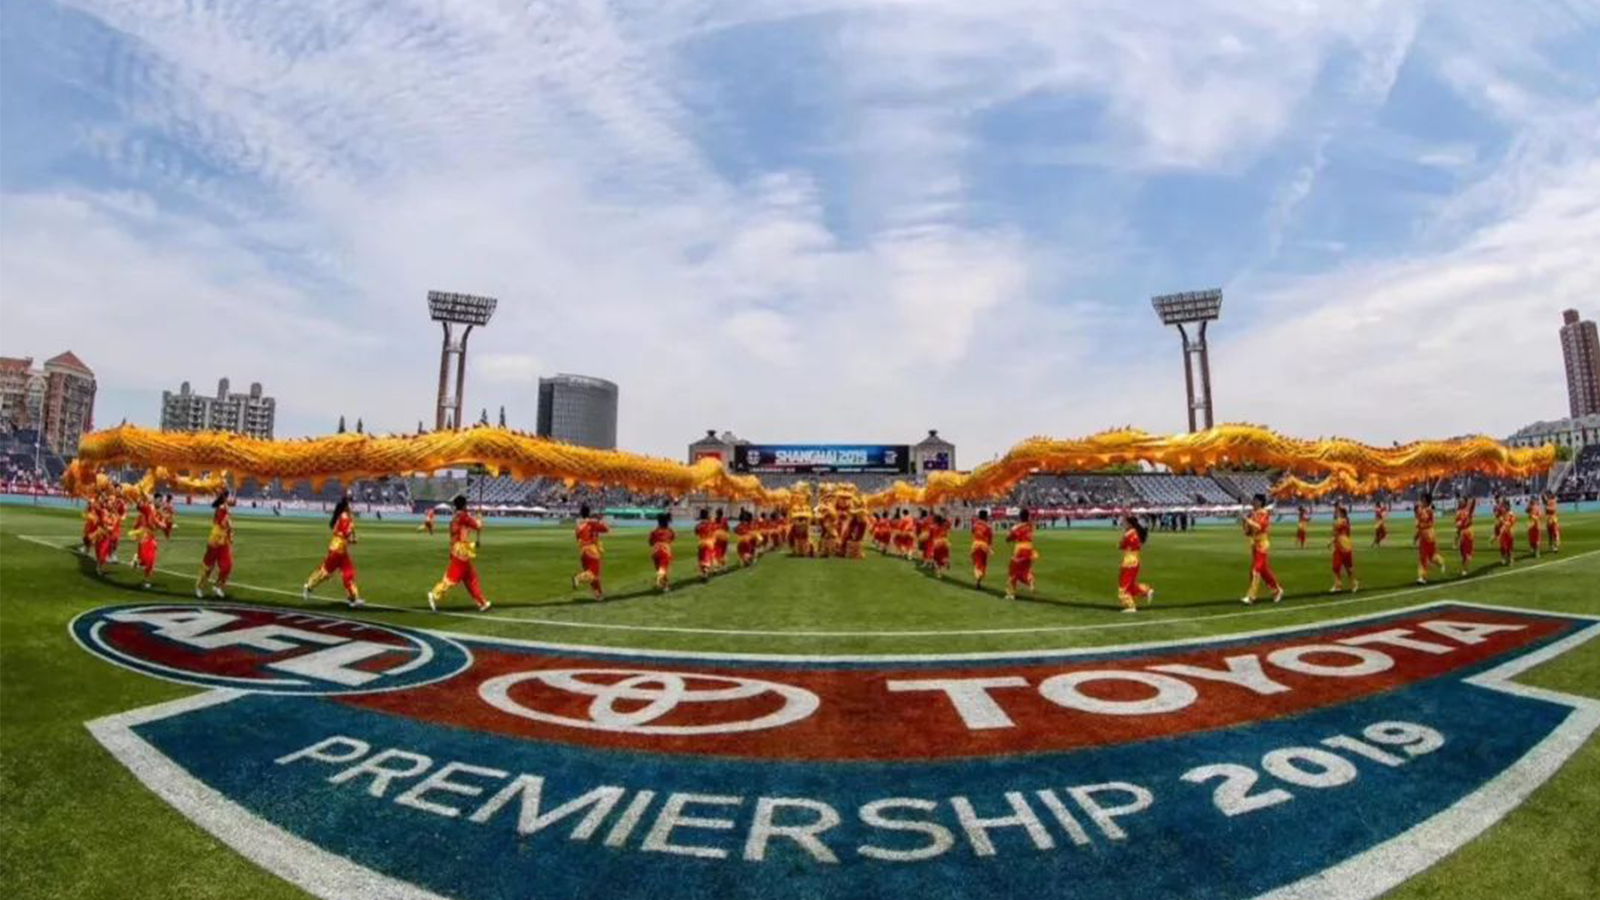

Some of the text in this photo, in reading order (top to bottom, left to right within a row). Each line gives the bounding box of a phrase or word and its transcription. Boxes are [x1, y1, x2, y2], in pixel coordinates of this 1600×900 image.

[775, 449, 868, 465] SHANGHAI 2019
[103, 607, 392, 686] AFL
[886, 618, 1528, 730] TOYOTA
[275, 720, 1446, 863] PREMIERSHIP 2019
